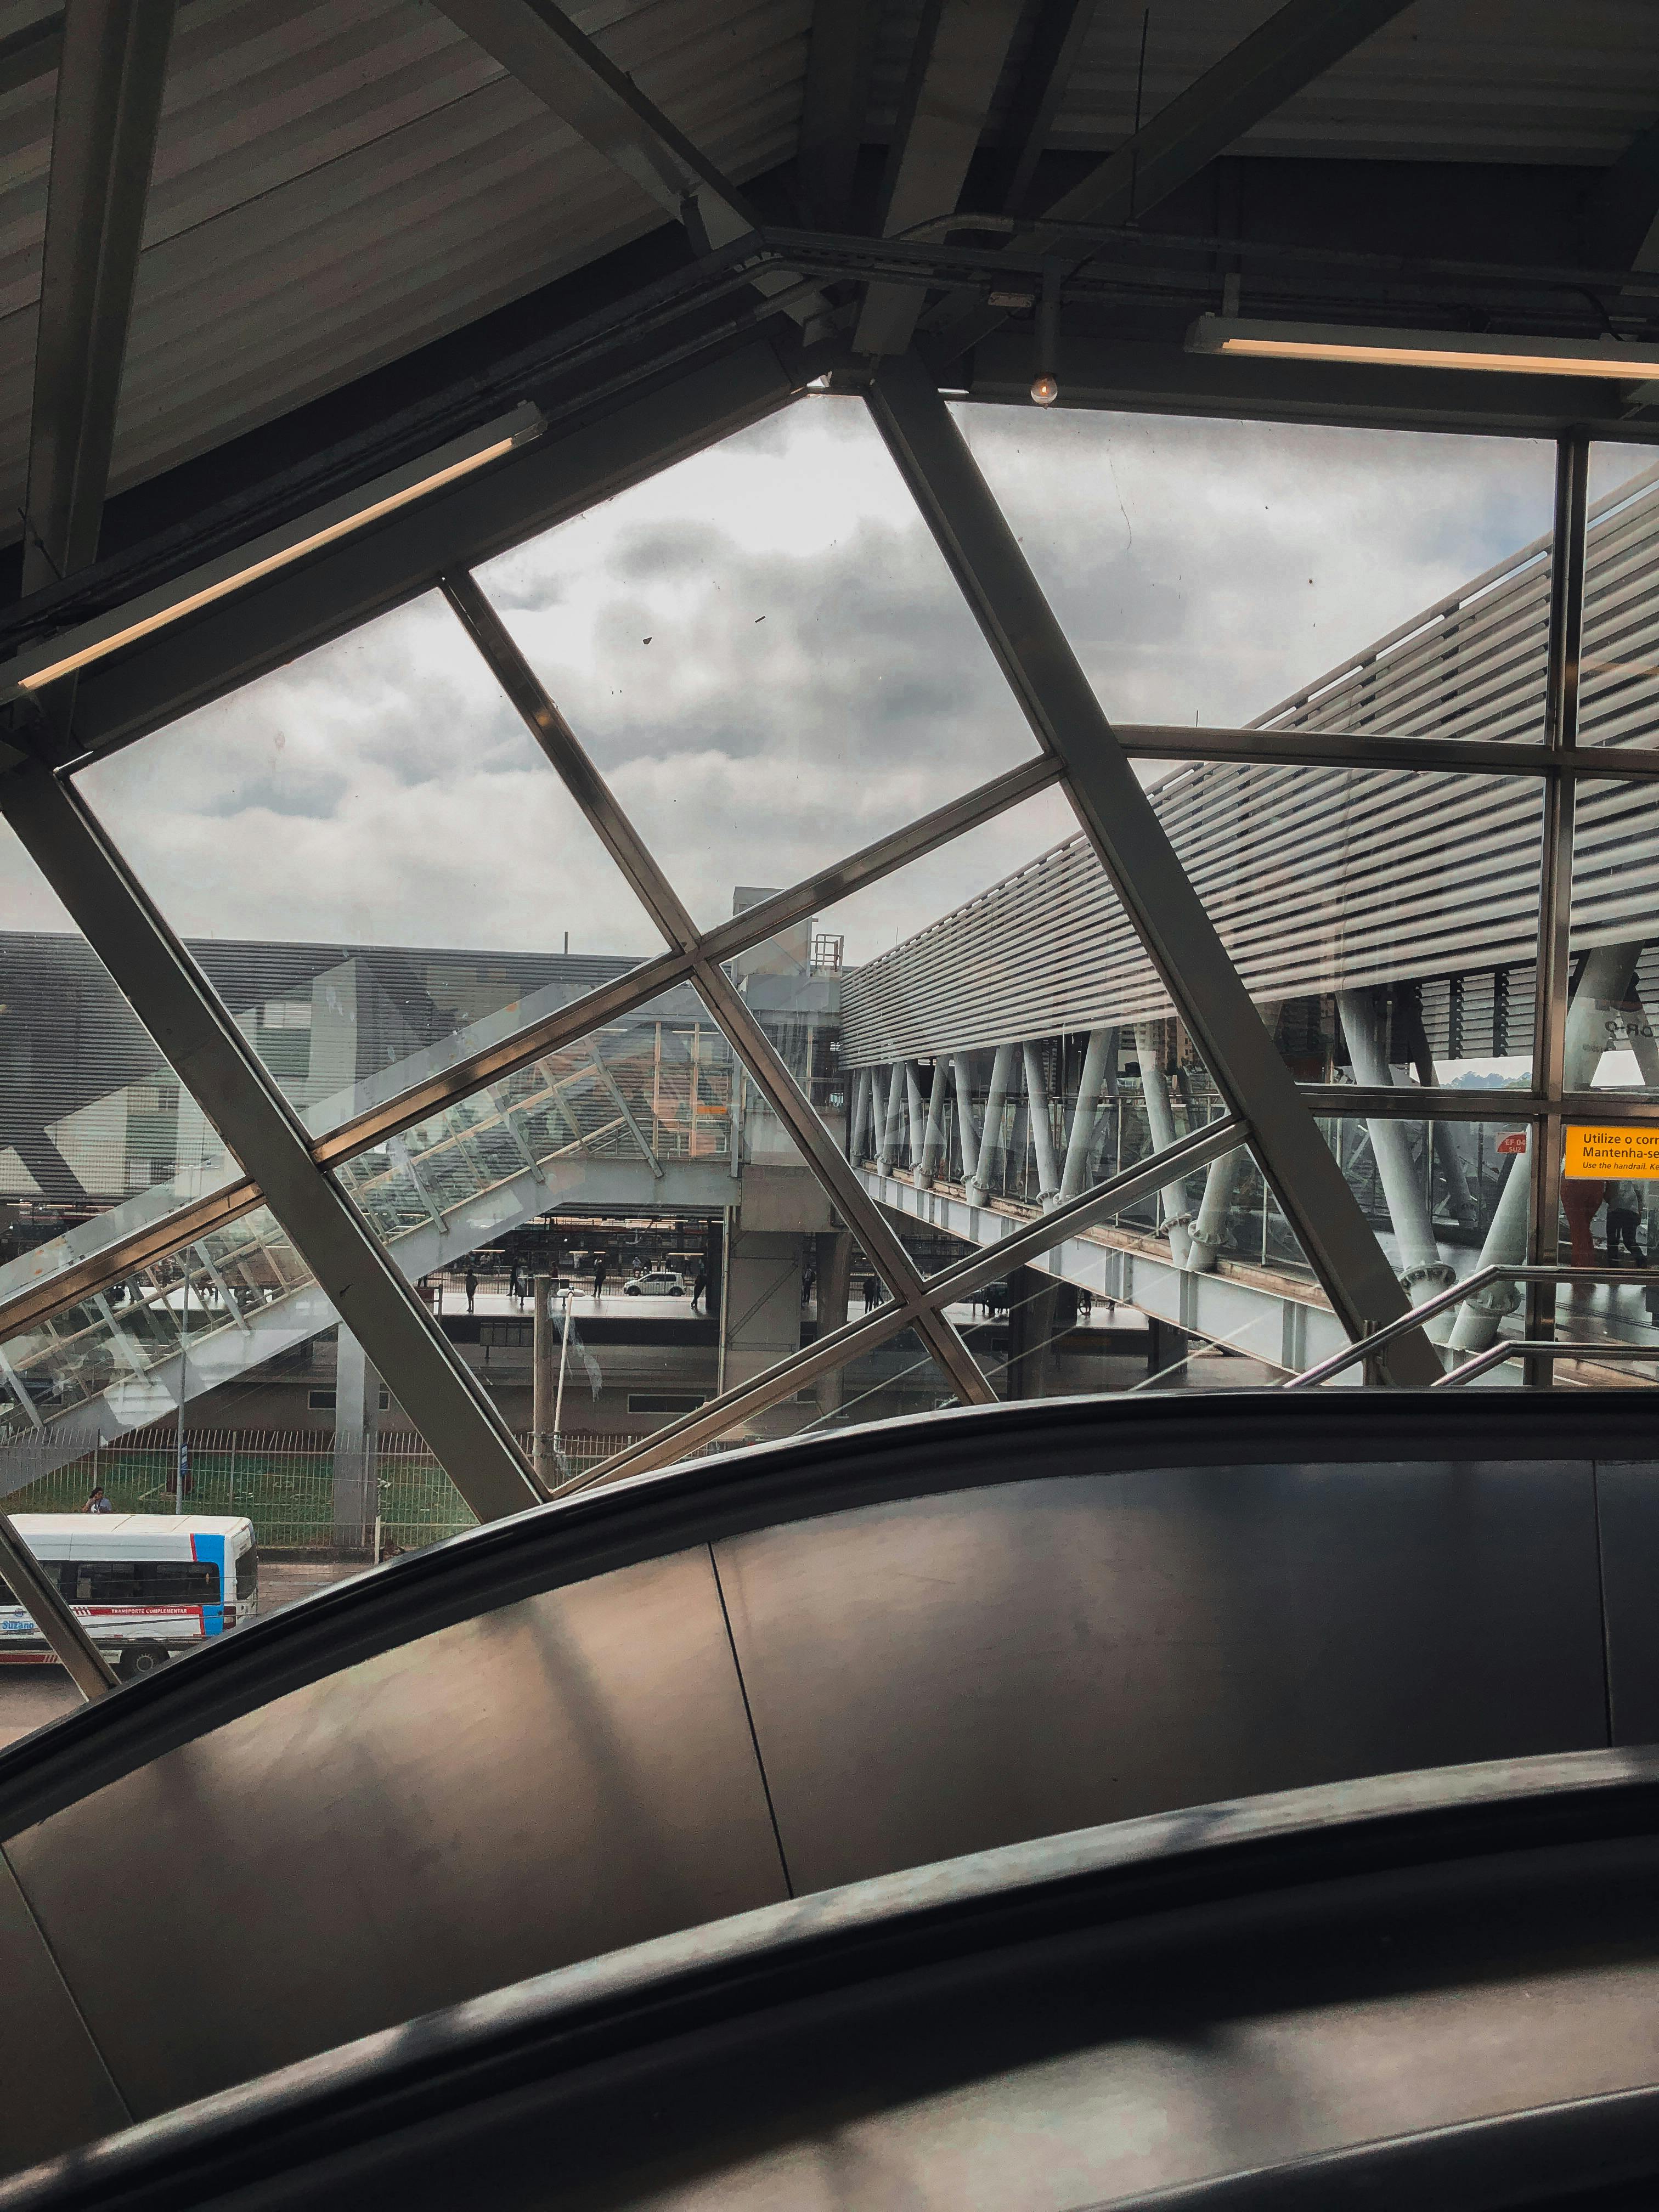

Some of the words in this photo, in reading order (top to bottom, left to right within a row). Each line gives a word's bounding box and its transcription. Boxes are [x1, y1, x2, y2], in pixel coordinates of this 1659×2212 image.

[1583, 1133, 1621, 1143] Utilize
[1624, 1136, 1632, 1144] o
[1636, 1136, 1659, 1144] corr
[1583, 1147, 1659, 1159] Mantenha-se
[1613, 1162, 1647, 1170] handrail.
[2, 1621, 34, 1629] Suzano
